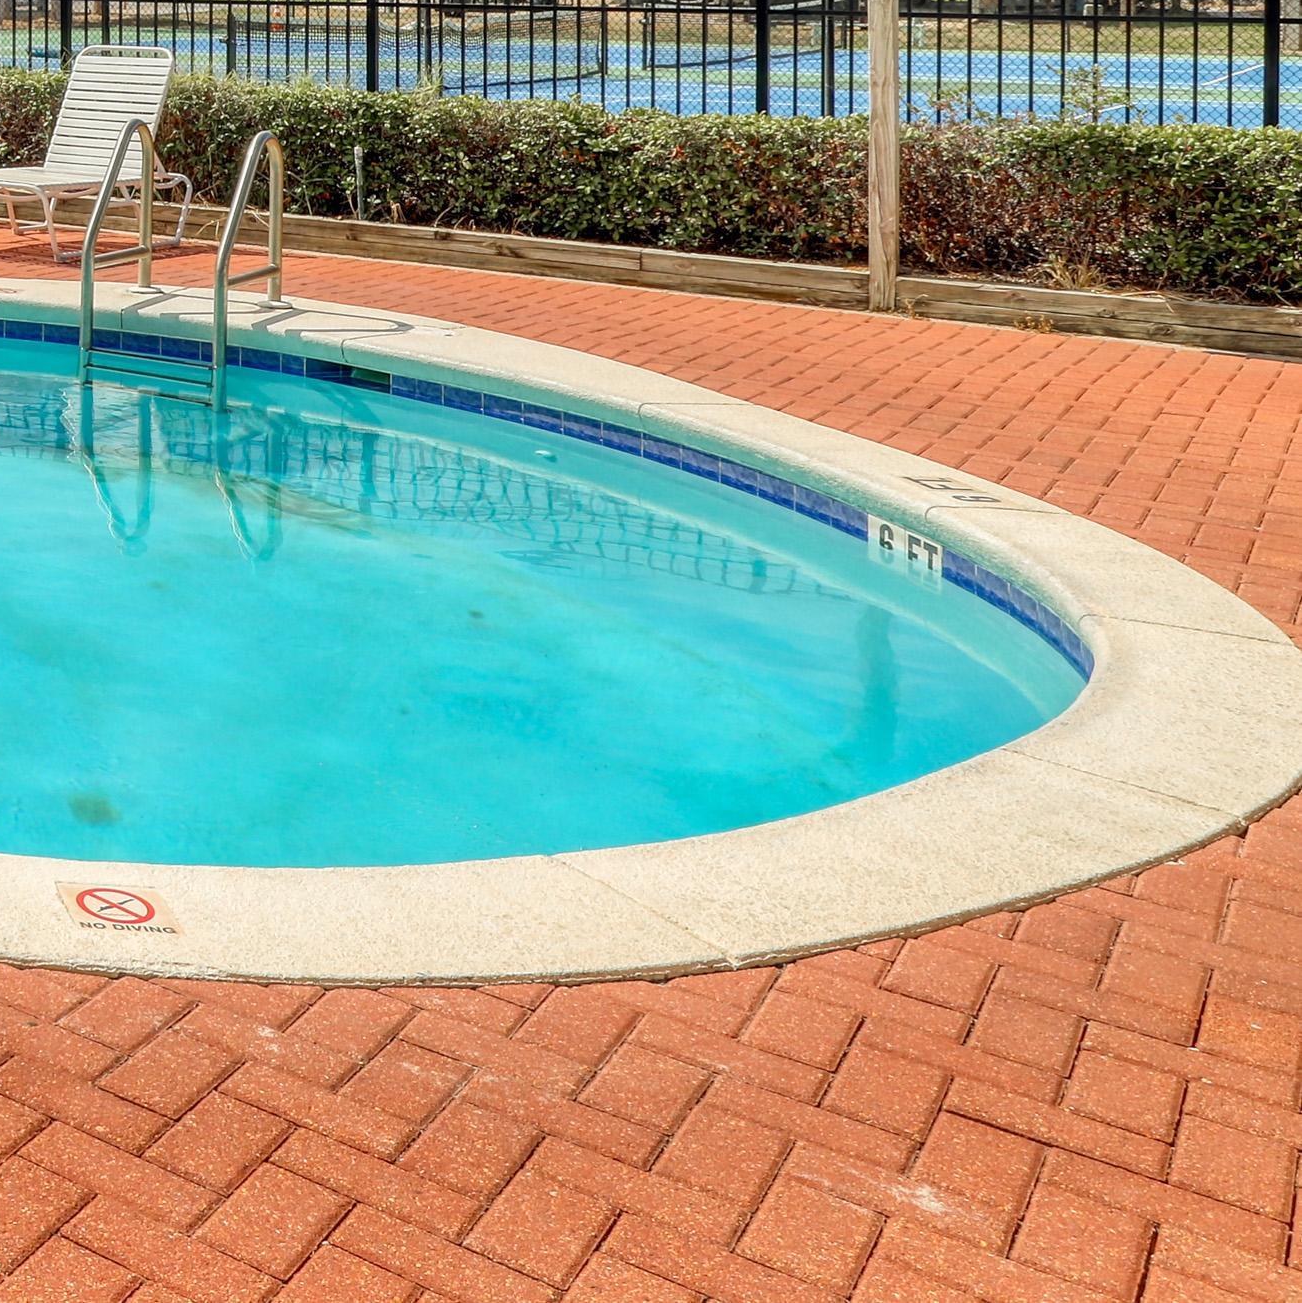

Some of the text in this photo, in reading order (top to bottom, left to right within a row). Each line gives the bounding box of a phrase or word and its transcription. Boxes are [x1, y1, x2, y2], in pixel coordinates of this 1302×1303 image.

[907, 533, 939, 571] FT
[79, 921, 178, 935] NO DIVING
